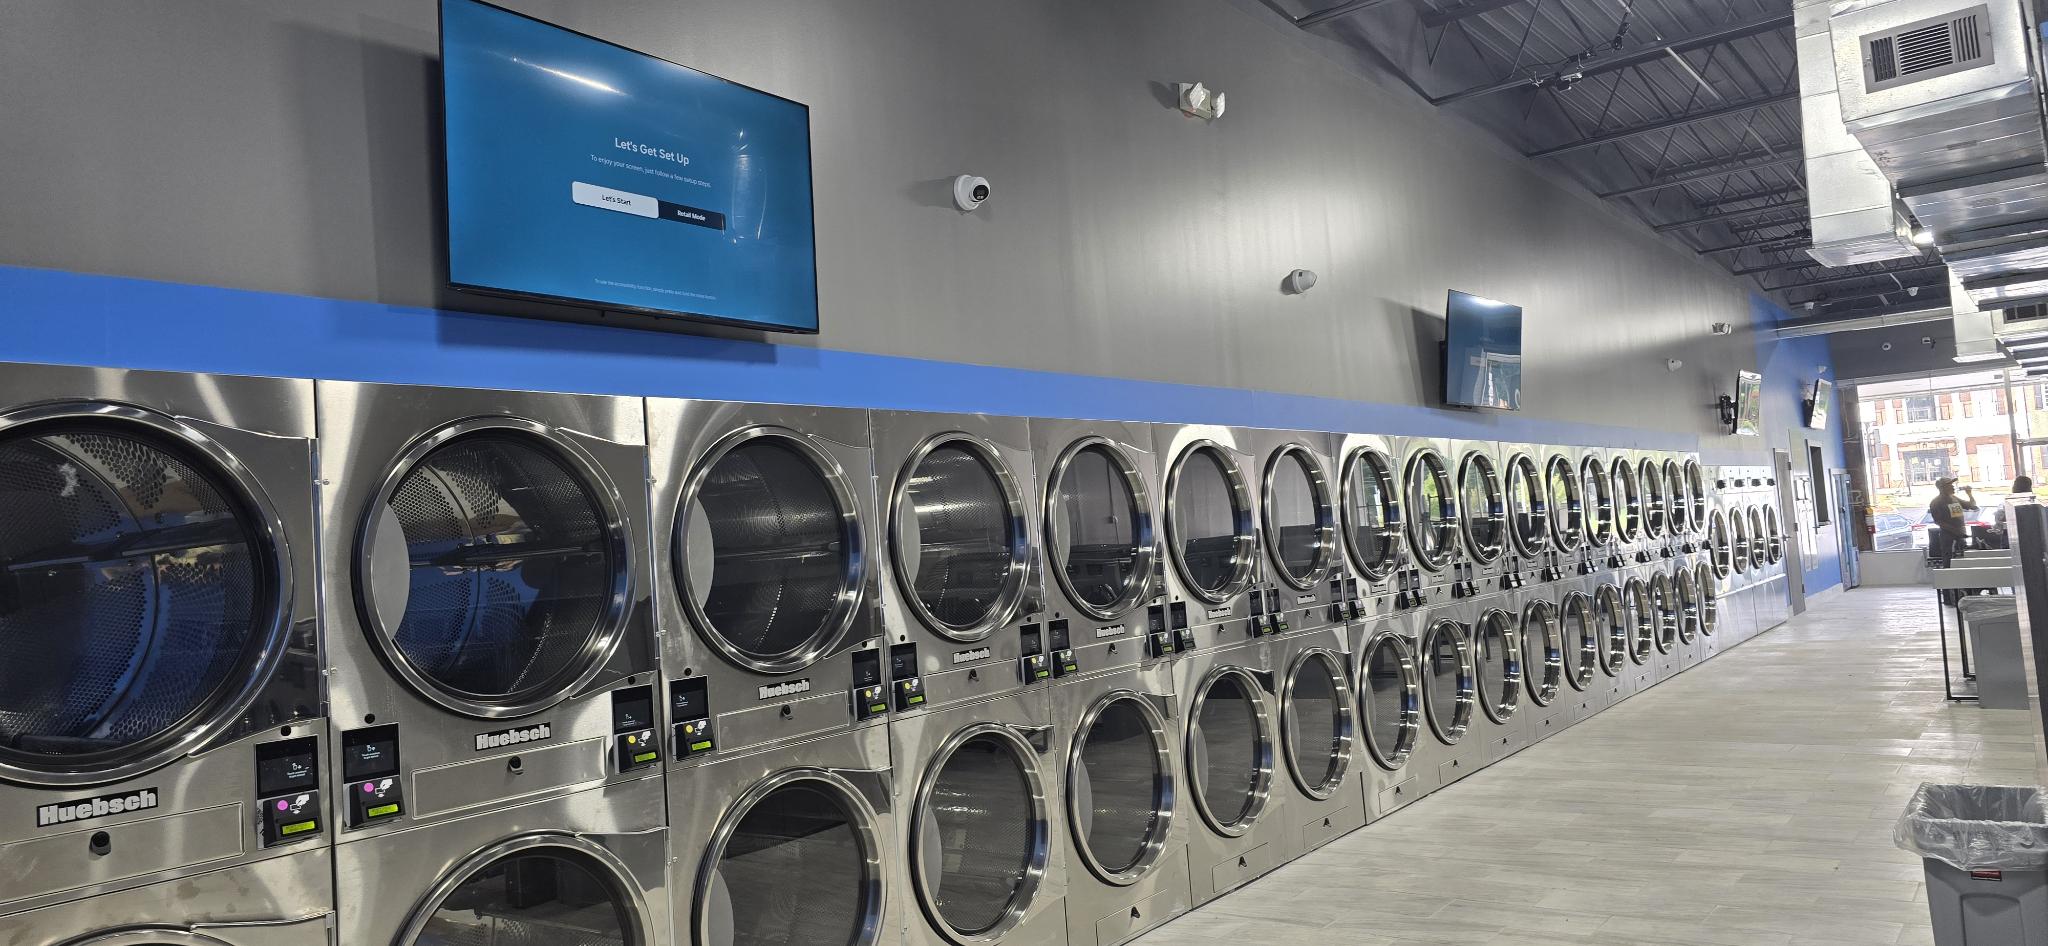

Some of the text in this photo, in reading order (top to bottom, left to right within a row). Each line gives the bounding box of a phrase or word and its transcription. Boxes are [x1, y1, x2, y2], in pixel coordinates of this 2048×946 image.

[591, 154, 598, 162] To
[615, 137, 690, 167] Let's Get Set Up
[617, 197, 631, 206] Start
[677, 210, 706, 221] Retail Mode
[759, 679, 810, 700] Huebsch
[476, 724, 551, 750] Huebsch
[39, 790, 157, 826] Huebsch
